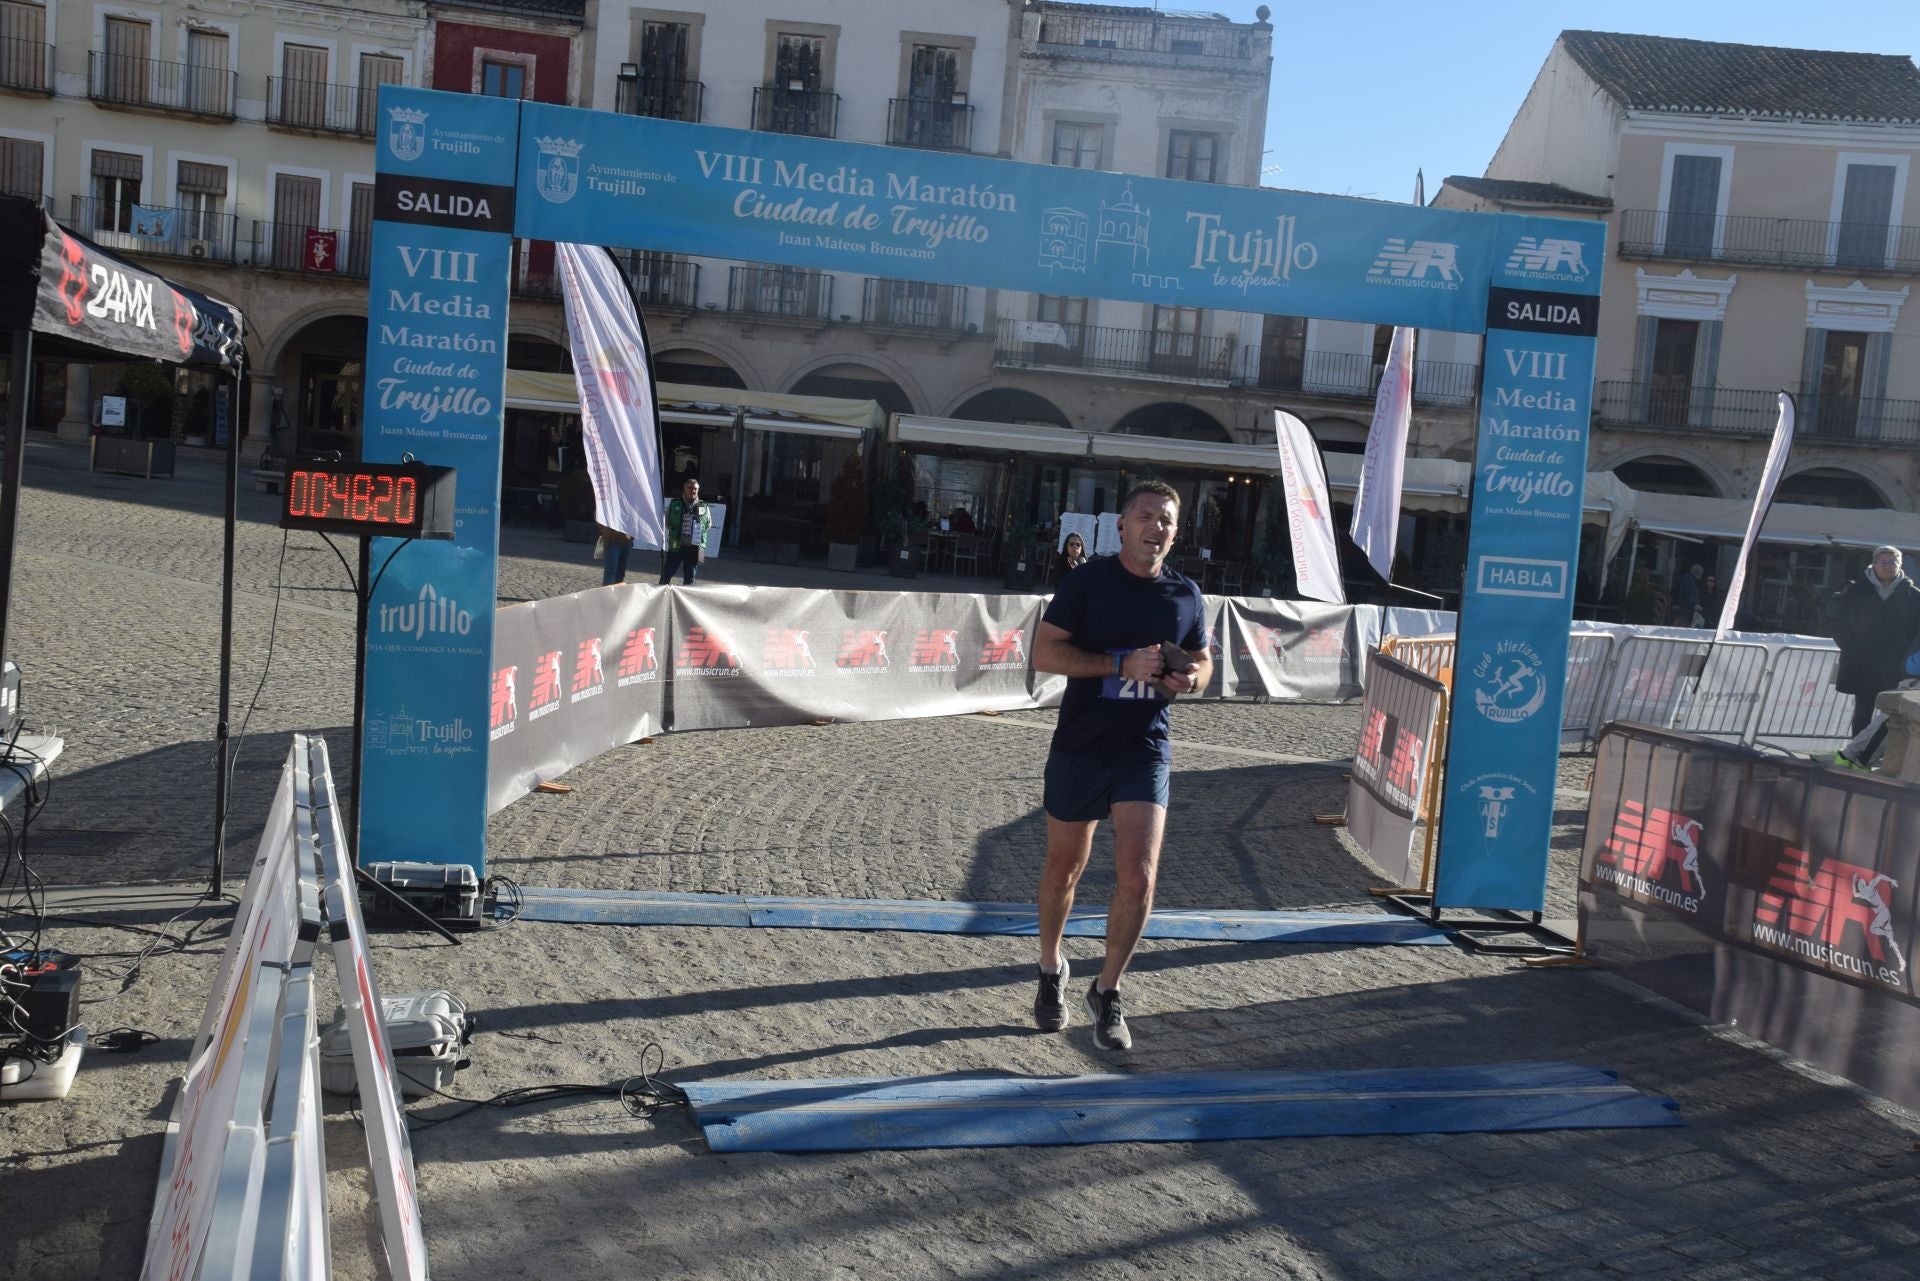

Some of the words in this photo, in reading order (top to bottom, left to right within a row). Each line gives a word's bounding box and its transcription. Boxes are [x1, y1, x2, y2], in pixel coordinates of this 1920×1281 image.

[432, 128, 492, 142] Ayuntamiento
[494, 134, 505, 144] de
[432, 138, 480, 155] Trujillo
[588, 163, 661, 181] Ayuntamiento
[664, 172, 677, 183] de
[695, 150, 764, 184] VIII
[773, 160, 875, 198] Media
[886, 173, 1017, 213] Maratón
[587, 176, 646, 197] Trujillo
[397, 190, 492, 219] SALIDA
[734, 189, 840, 226] Ciudad
[844, 204, 883, 231] de
[891, 205, 989, 249] Trujillo
[778, 231, 811, 247] Juan
[815, 235, 866, 253] Mateos
[870, 241, 936, 261] Broncano
[1186, 211, 1318, 280] Trujillo
[397, 246, 479, 283] VIII
[1213, 265, 1227, 286] te
[1504, 268, 1585, 283] www.musicrun.es
[1365, 275, 1459, 291] www.musicrun.es
[388, 289, 491, 320] Media
[1507, 302, 1581, 325] SALIDA
[379, 325, 497, 353] Maratón
[393, 357, 455, 377] Ciudad
[457, 364, 480, 379] de
[1504, 349, 1568, 380] VIII
[377, 377, 491, 424] Trujillo
[1496, 387, 1577, 412] Media
[381, 425, 403, 436] Juan
[405, 427, 440, 438] Mateos
[442, 429, 487, 441] Broncano
[1488, 418, 1581, 442] Maratón
[1496, 446, 1545, 464] Ciudad
[1546, 450, 1566, 465] de
[1484, 464, 1574, 504] Trujillo
[289, 471, 417, 524] 00:48:20
[1485, 505, 1503, 515] Juan
[1505, 507, 1532, 517] Mateos
[1490, 568, 1553, 587] HABLA
[1473, 652, 1492, 678] Club
[1497, 639, 1543, 667] Atletismo
[676, 667, 739, 677] www.musicrun.es
[1480, 702, 1528, 719] TRUJILLO
[416, 718, 473, 743] Trujillo
[1596, 863, 1699, 913] www.musicrun.es
[1752, 922, 1901, 987] www.musicrun.es
